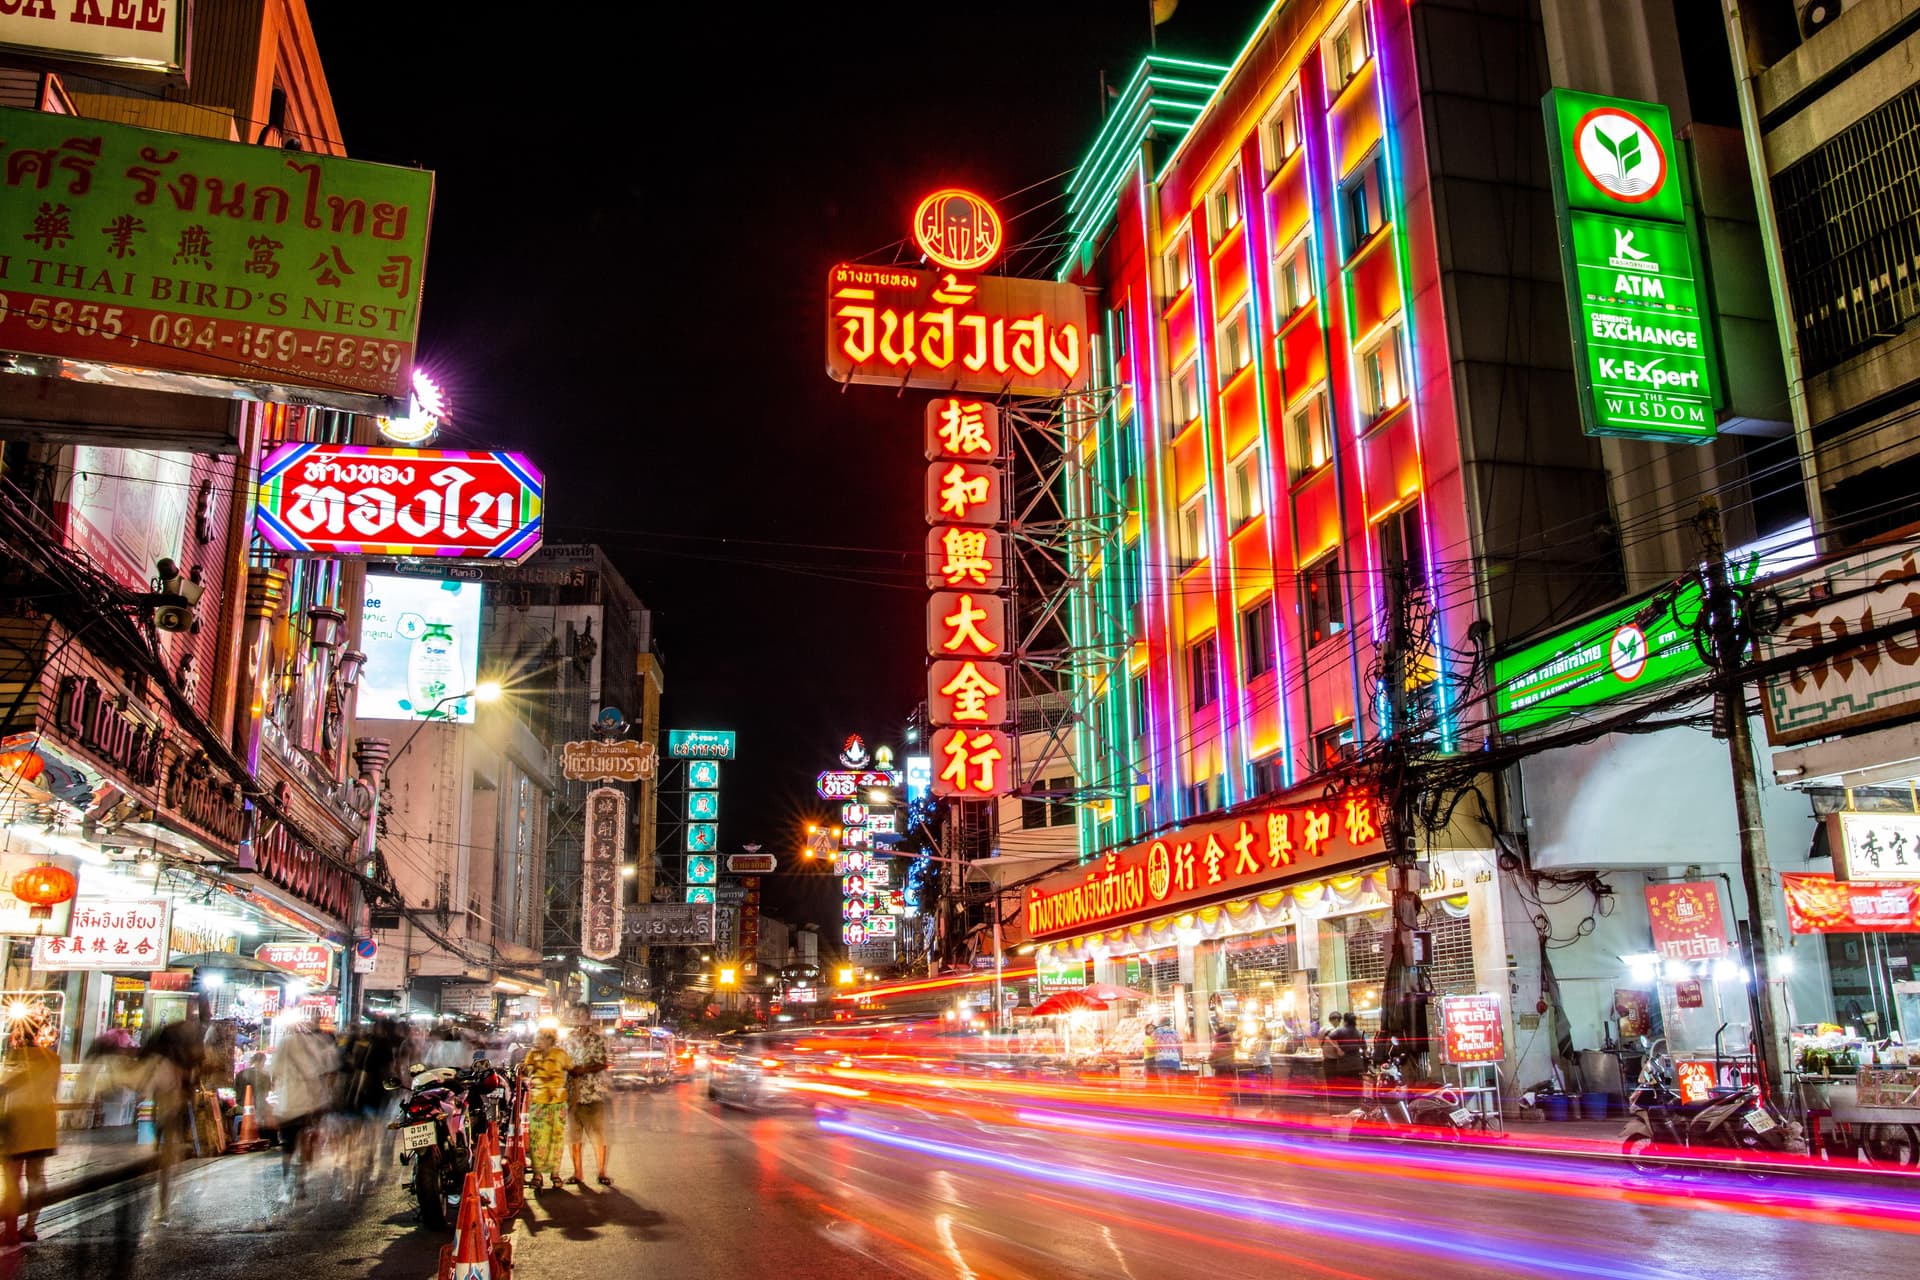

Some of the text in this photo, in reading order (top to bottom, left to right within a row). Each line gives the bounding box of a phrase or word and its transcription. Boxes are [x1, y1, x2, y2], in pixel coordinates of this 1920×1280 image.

[125, 147, 410, 242] รังนกไทย
[836, 263, 917, 287] ห้างขายทอง
[1614, 274, 1665, 299] ATM
[26, 258, 137, 296] THAI
[149, 275, 288, 317] BIRD'S
[301, 296, 407, 332] NEST
[1590, 313, 1633, 325] CURRENCY
[149, 313, 402, 375] 094-159-5859
[1591, 320, 1698, 349] EXCHANGE
[1598, 357, 1699, 390] K-Expert
[1605, 398, 1705, 422] WISDOM
[1643, 392, 1664, 402] THE
[303, 455, 415, 486] ห้างทอง
[937, 398, 1003, 793] 振和興大金行
